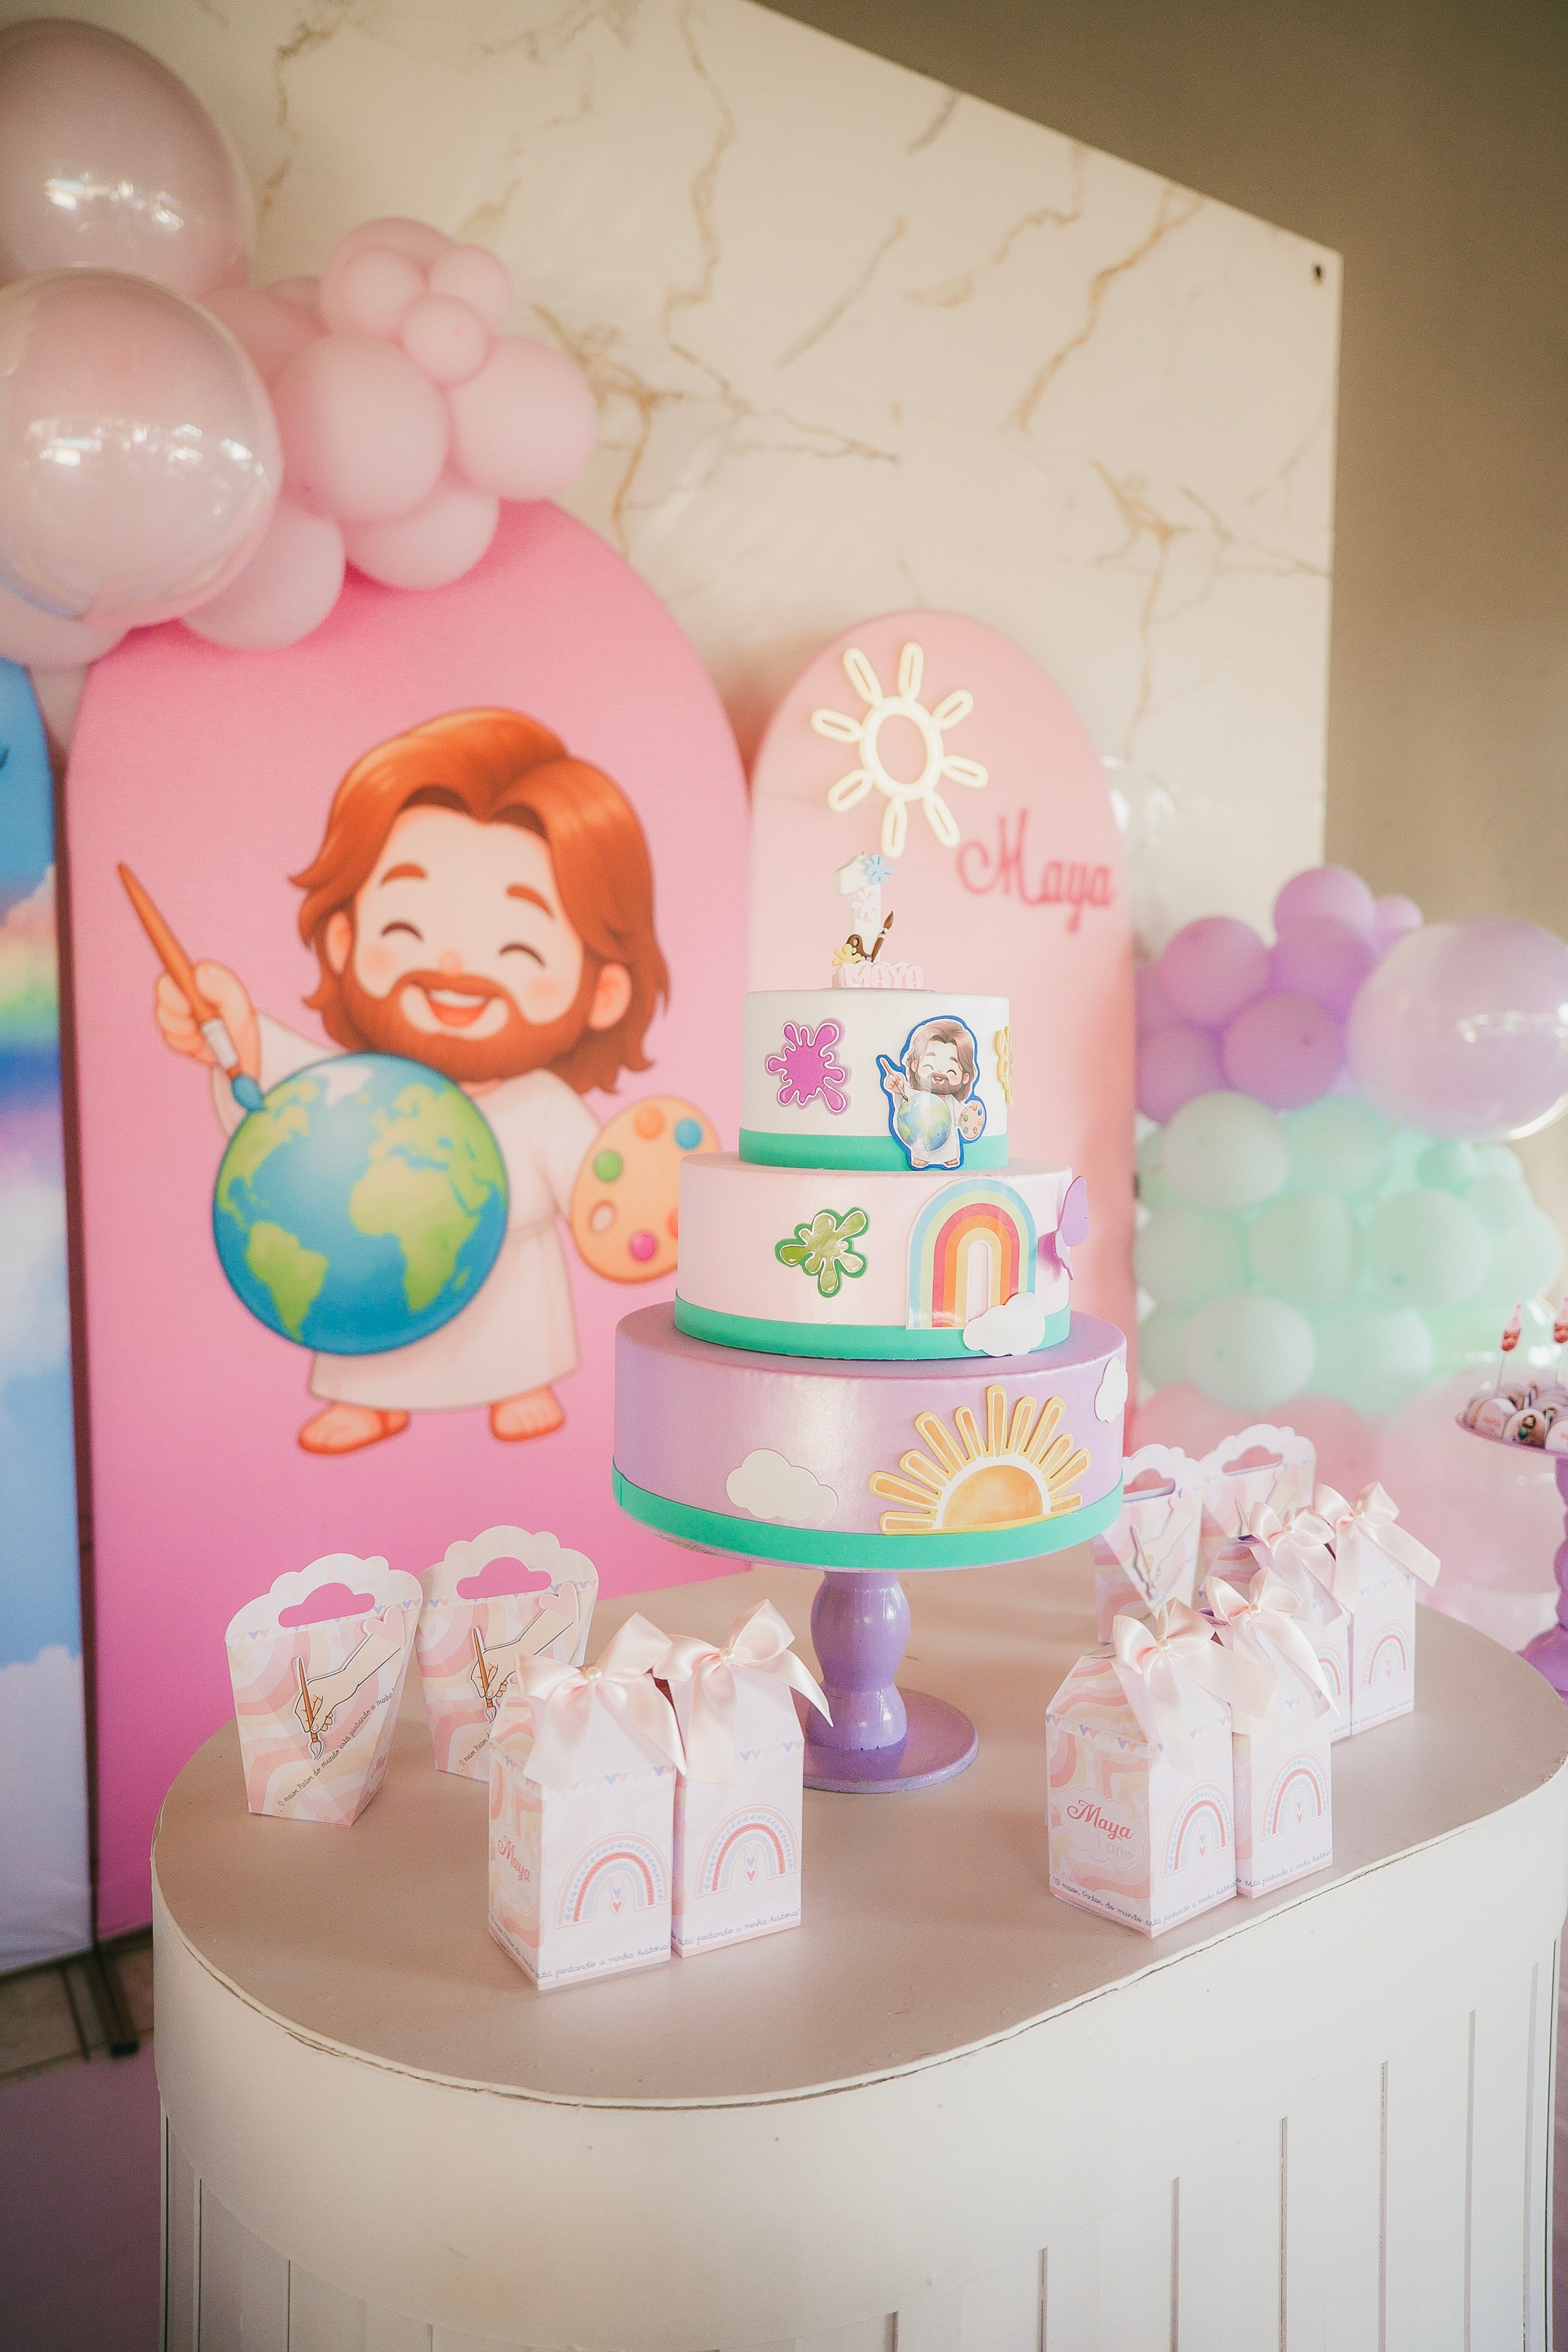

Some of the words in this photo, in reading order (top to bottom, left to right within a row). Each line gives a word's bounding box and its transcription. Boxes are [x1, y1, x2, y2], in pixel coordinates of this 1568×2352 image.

[956, 808, 1116, 934] Maya
[838, 962, 924, 989] MAYA
[284, 1789, 300, 1802] maior
[296, 1775, 314, 1790] Pintor
[313, 1768, 322, 1776] do
[321, 1749, 340, 1768] mundo
[349, 1710, 371, 1737] pintando
[376, 1692, 393, 1706] minha
[1066, 1800, 1135, 1842] Maya
[498, 1834, 531, 1882] Maya
